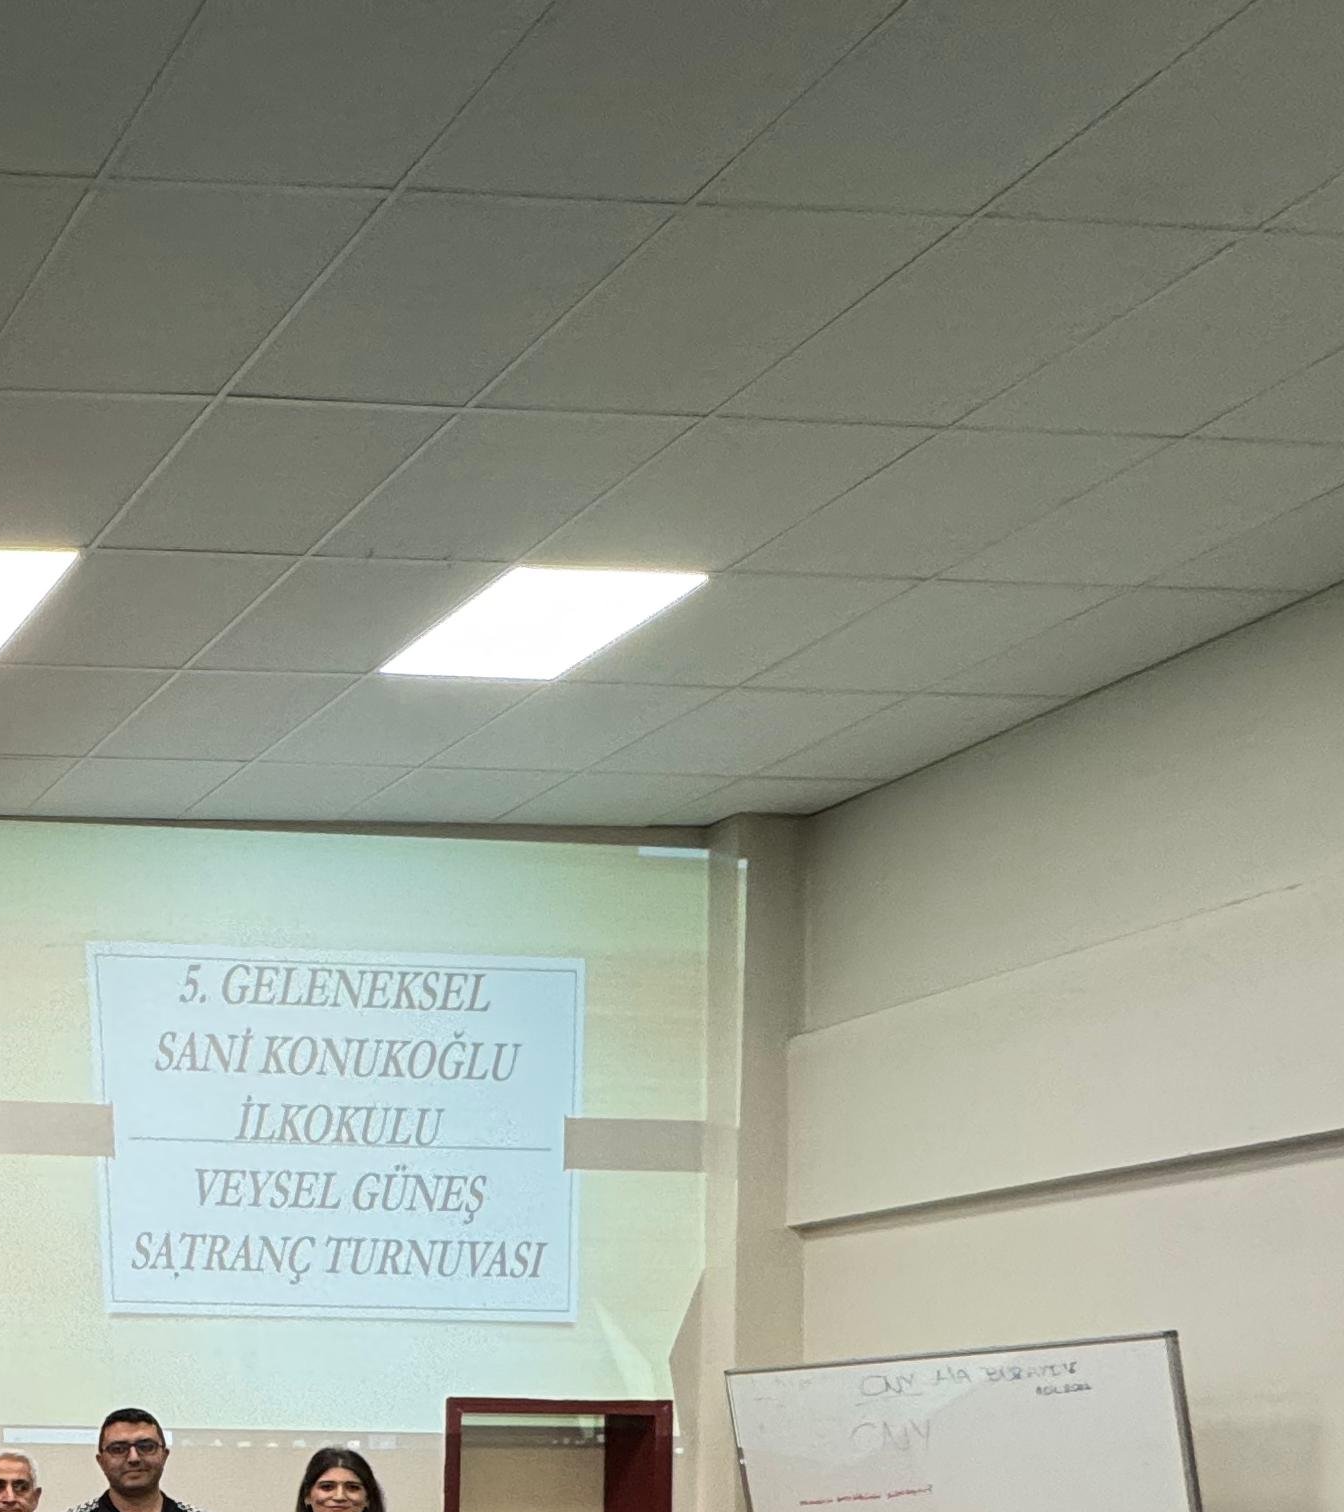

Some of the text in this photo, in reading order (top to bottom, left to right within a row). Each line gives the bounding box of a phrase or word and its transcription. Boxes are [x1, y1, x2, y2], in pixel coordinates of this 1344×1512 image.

[179, 963, 491, 1012] 5. GELENEKSEL
[258, 1028, 522, 1082] KONUKOĞLU
[234, 1094, 445, 1147] İLKOKULU
[194, 1164, 487, 1225] VEYSEL GÜNEŞ
[324, 1235, 548, 1279] TURNUVASI
